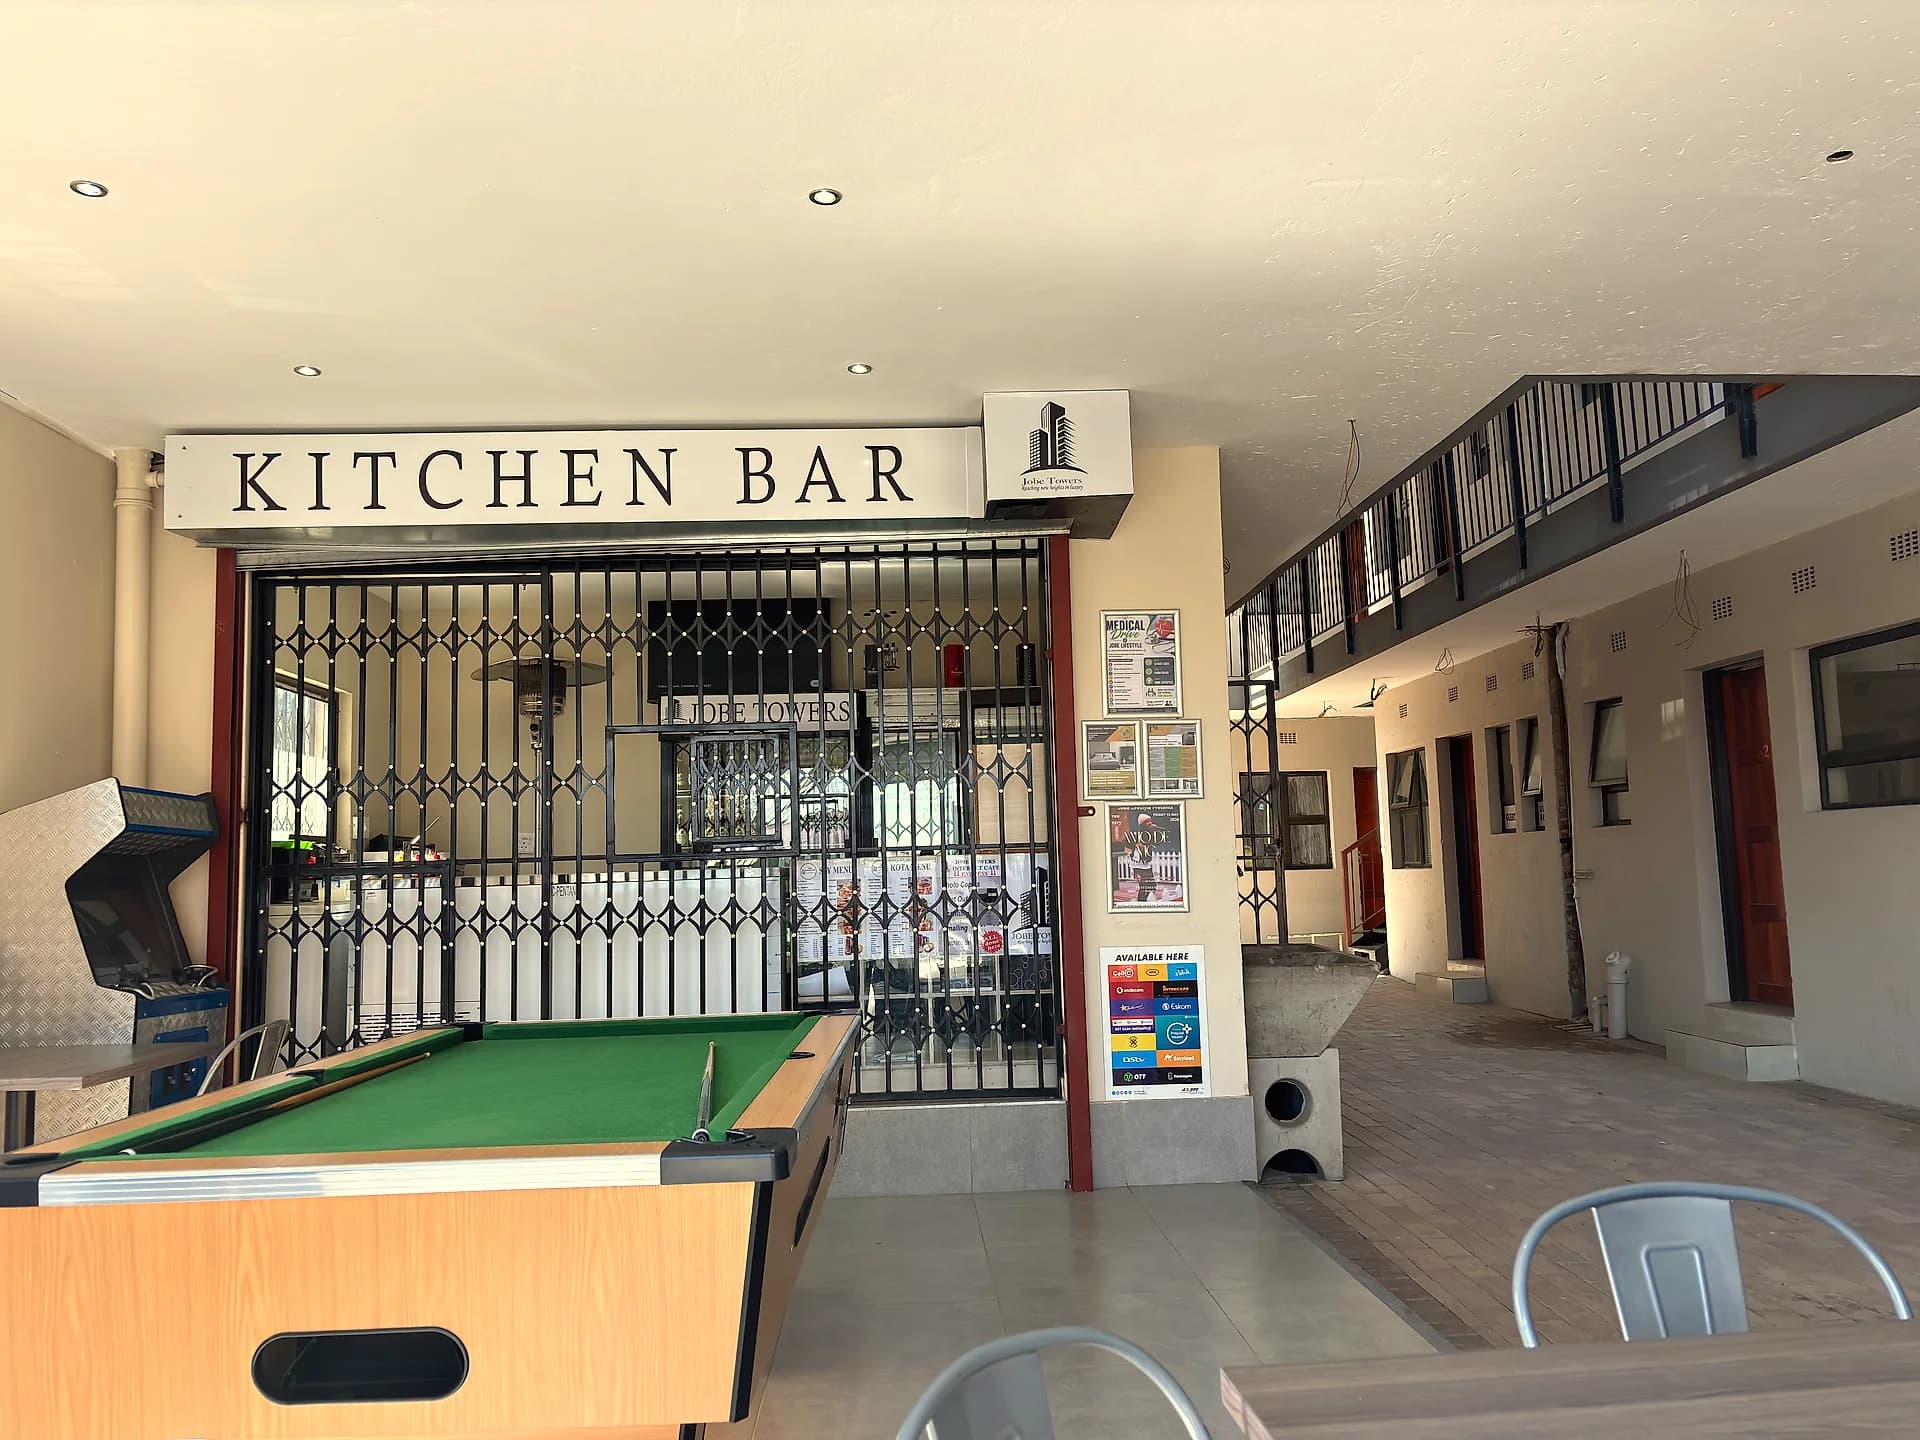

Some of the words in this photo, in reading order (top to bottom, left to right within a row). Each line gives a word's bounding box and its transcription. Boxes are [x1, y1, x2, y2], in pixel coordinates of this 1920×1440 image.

[232, 448, 678, 512] KITCHEN
[734, 445, 914, 504] BAR
[1022, 477, 1045, 486] Jobe
[1047, 476, 1083, 484] Towers
[1106, 620, 1145, 631] MEDICAL
[1111, 629, 1140, 639] Drive
[689, 702, 747, 724] JOBE
[752, 701, 850, 722] TOWERS
[948, 924, 968, 933] mailing
[1115, 953, 1164, 962] AVAILABLE
[1165, 952, 1190, 961] HERE
[1170, 1003, 1192, 1011] Eskom
